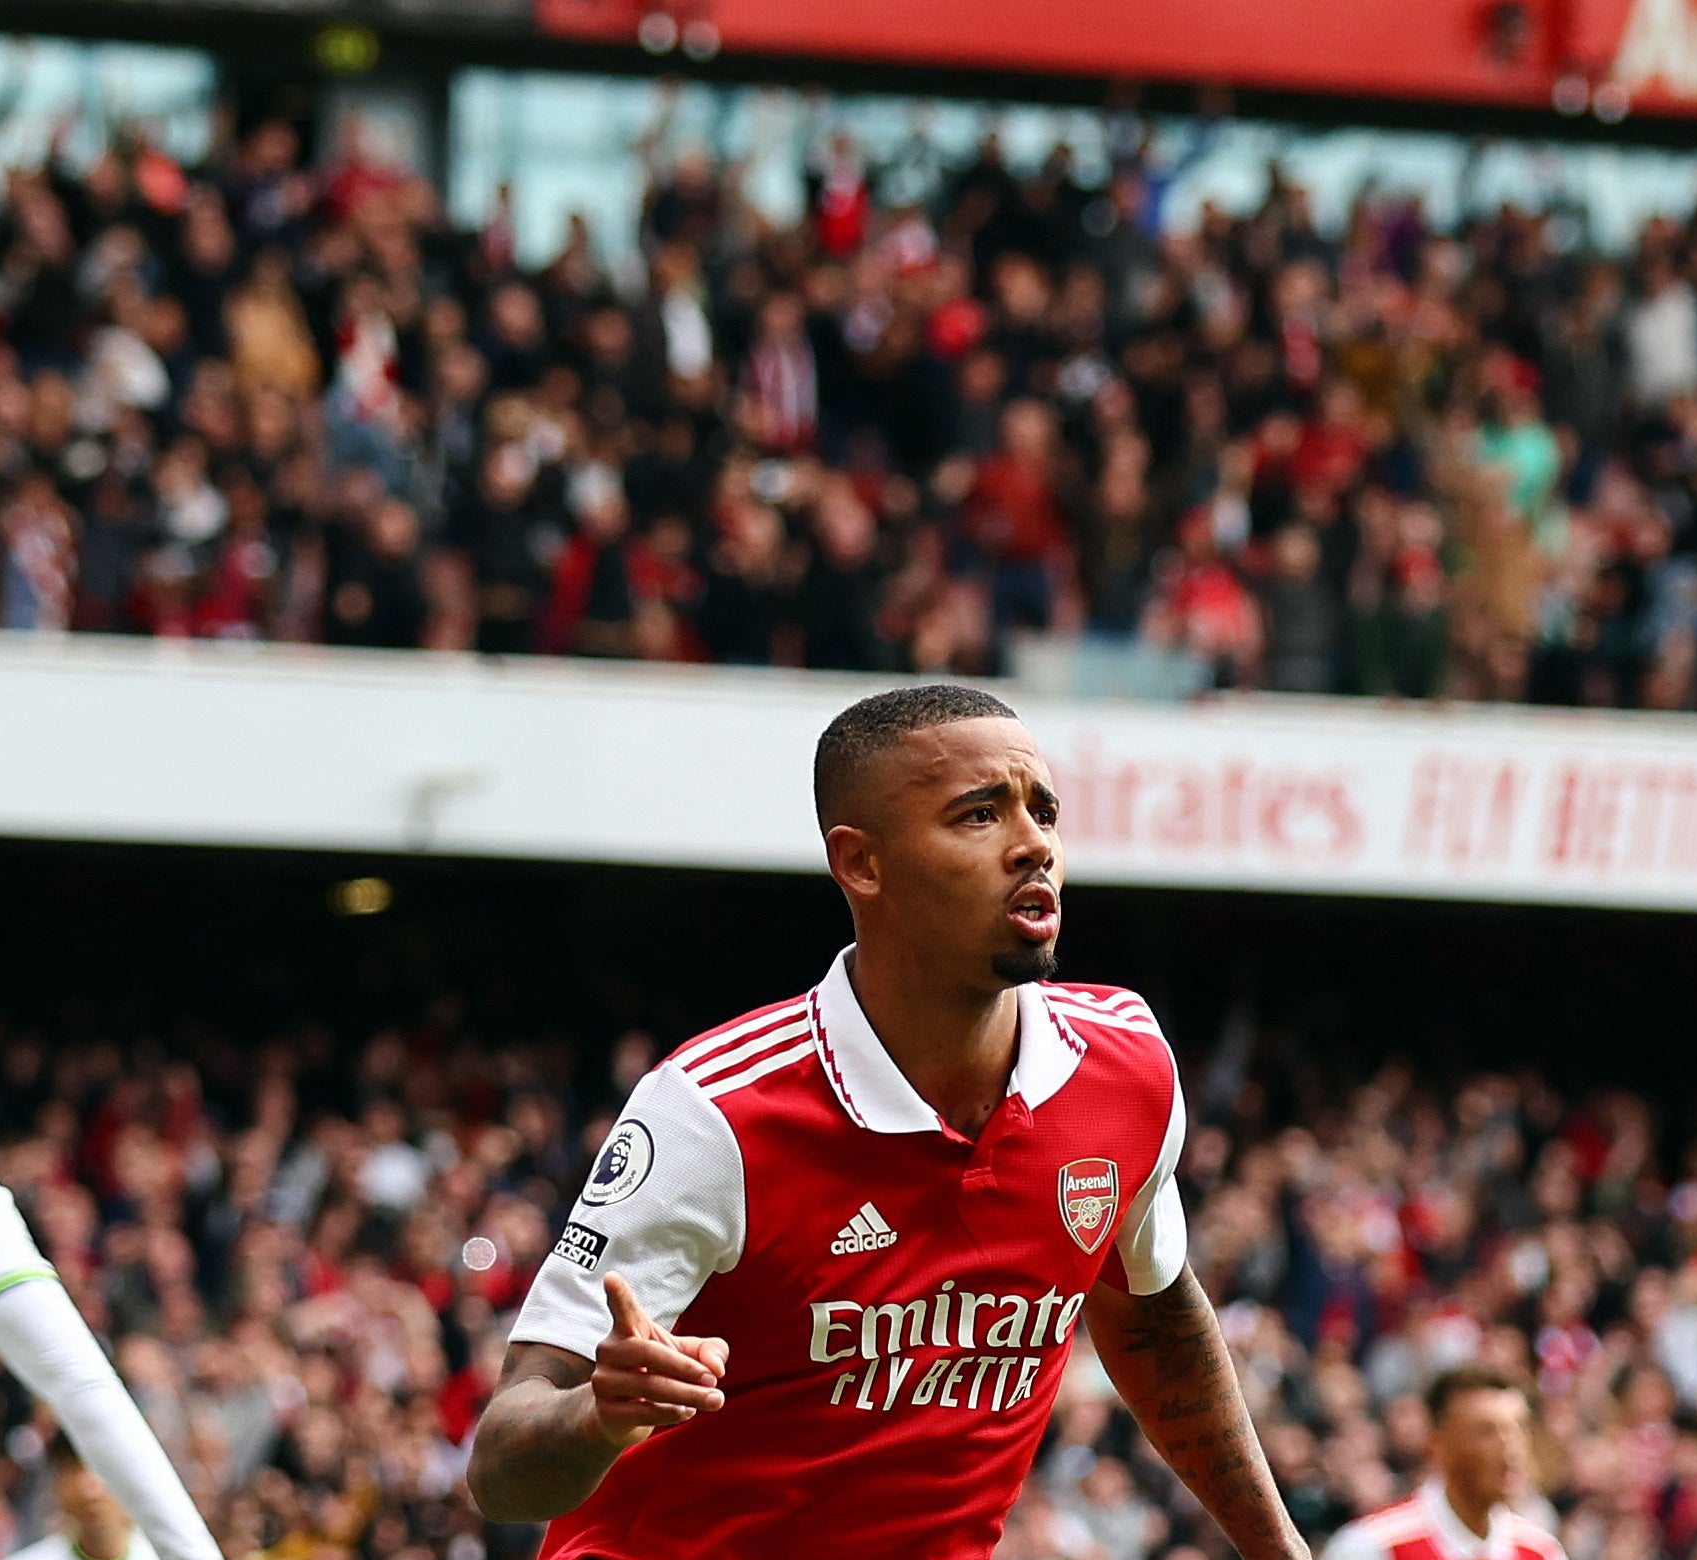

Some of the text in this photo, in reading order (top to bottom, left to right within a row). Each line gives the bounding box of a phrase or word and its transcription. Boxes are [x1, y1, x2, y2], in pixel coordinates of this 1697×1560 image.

[1405, 748, 1526, 864] FLY
[1066, 1171, 1112, 1192] Arsenal
[562, 1225, 598, 1252] oom
[830, 1231, 898, 1255] adidas
[554, 1239, 598, 1270] acism
[809, 1279, 1086, 1363] Emirate
